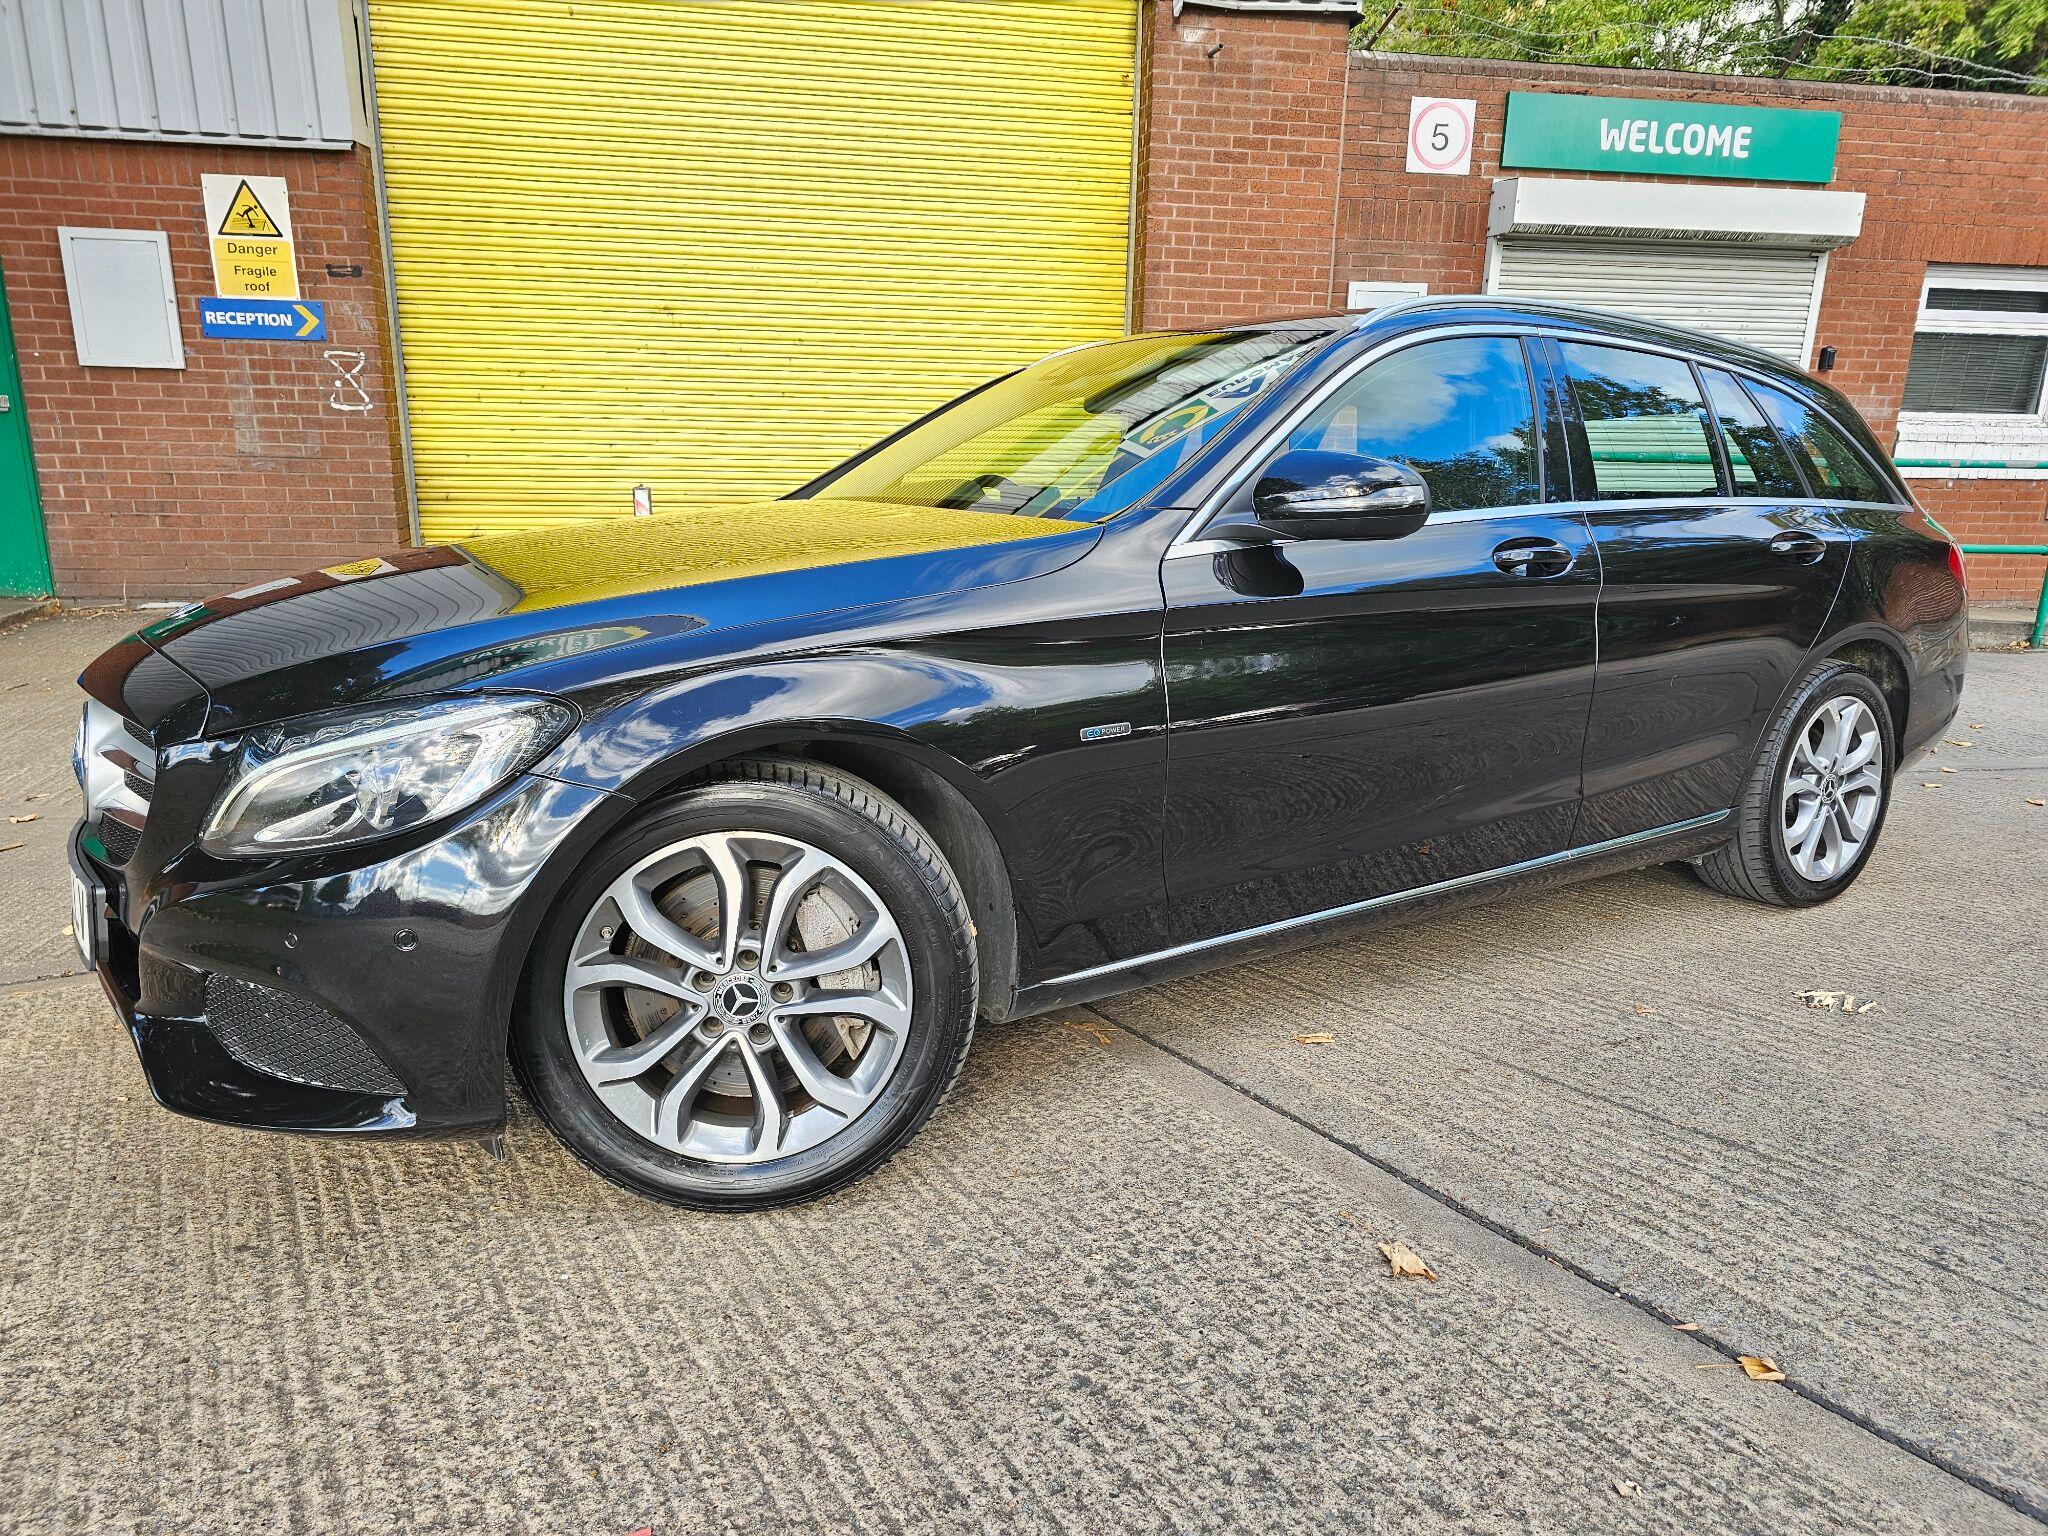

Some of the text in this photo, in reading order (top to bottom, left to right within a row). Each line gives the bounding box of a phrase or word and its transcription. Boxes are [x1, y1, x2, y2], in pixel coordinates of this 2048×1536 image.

[1430, 123, 1449, 151] 5
[1600, 118, 1753, 159] WELCOME
[227, 242, 278, 257] Danger
[234, 265, 277, 278] Fragile
[245, 281, 270, 292] roof
[205, 311, 293, 327] RECEPTION
[1087, 726, 1126, 738] EQ POWER
